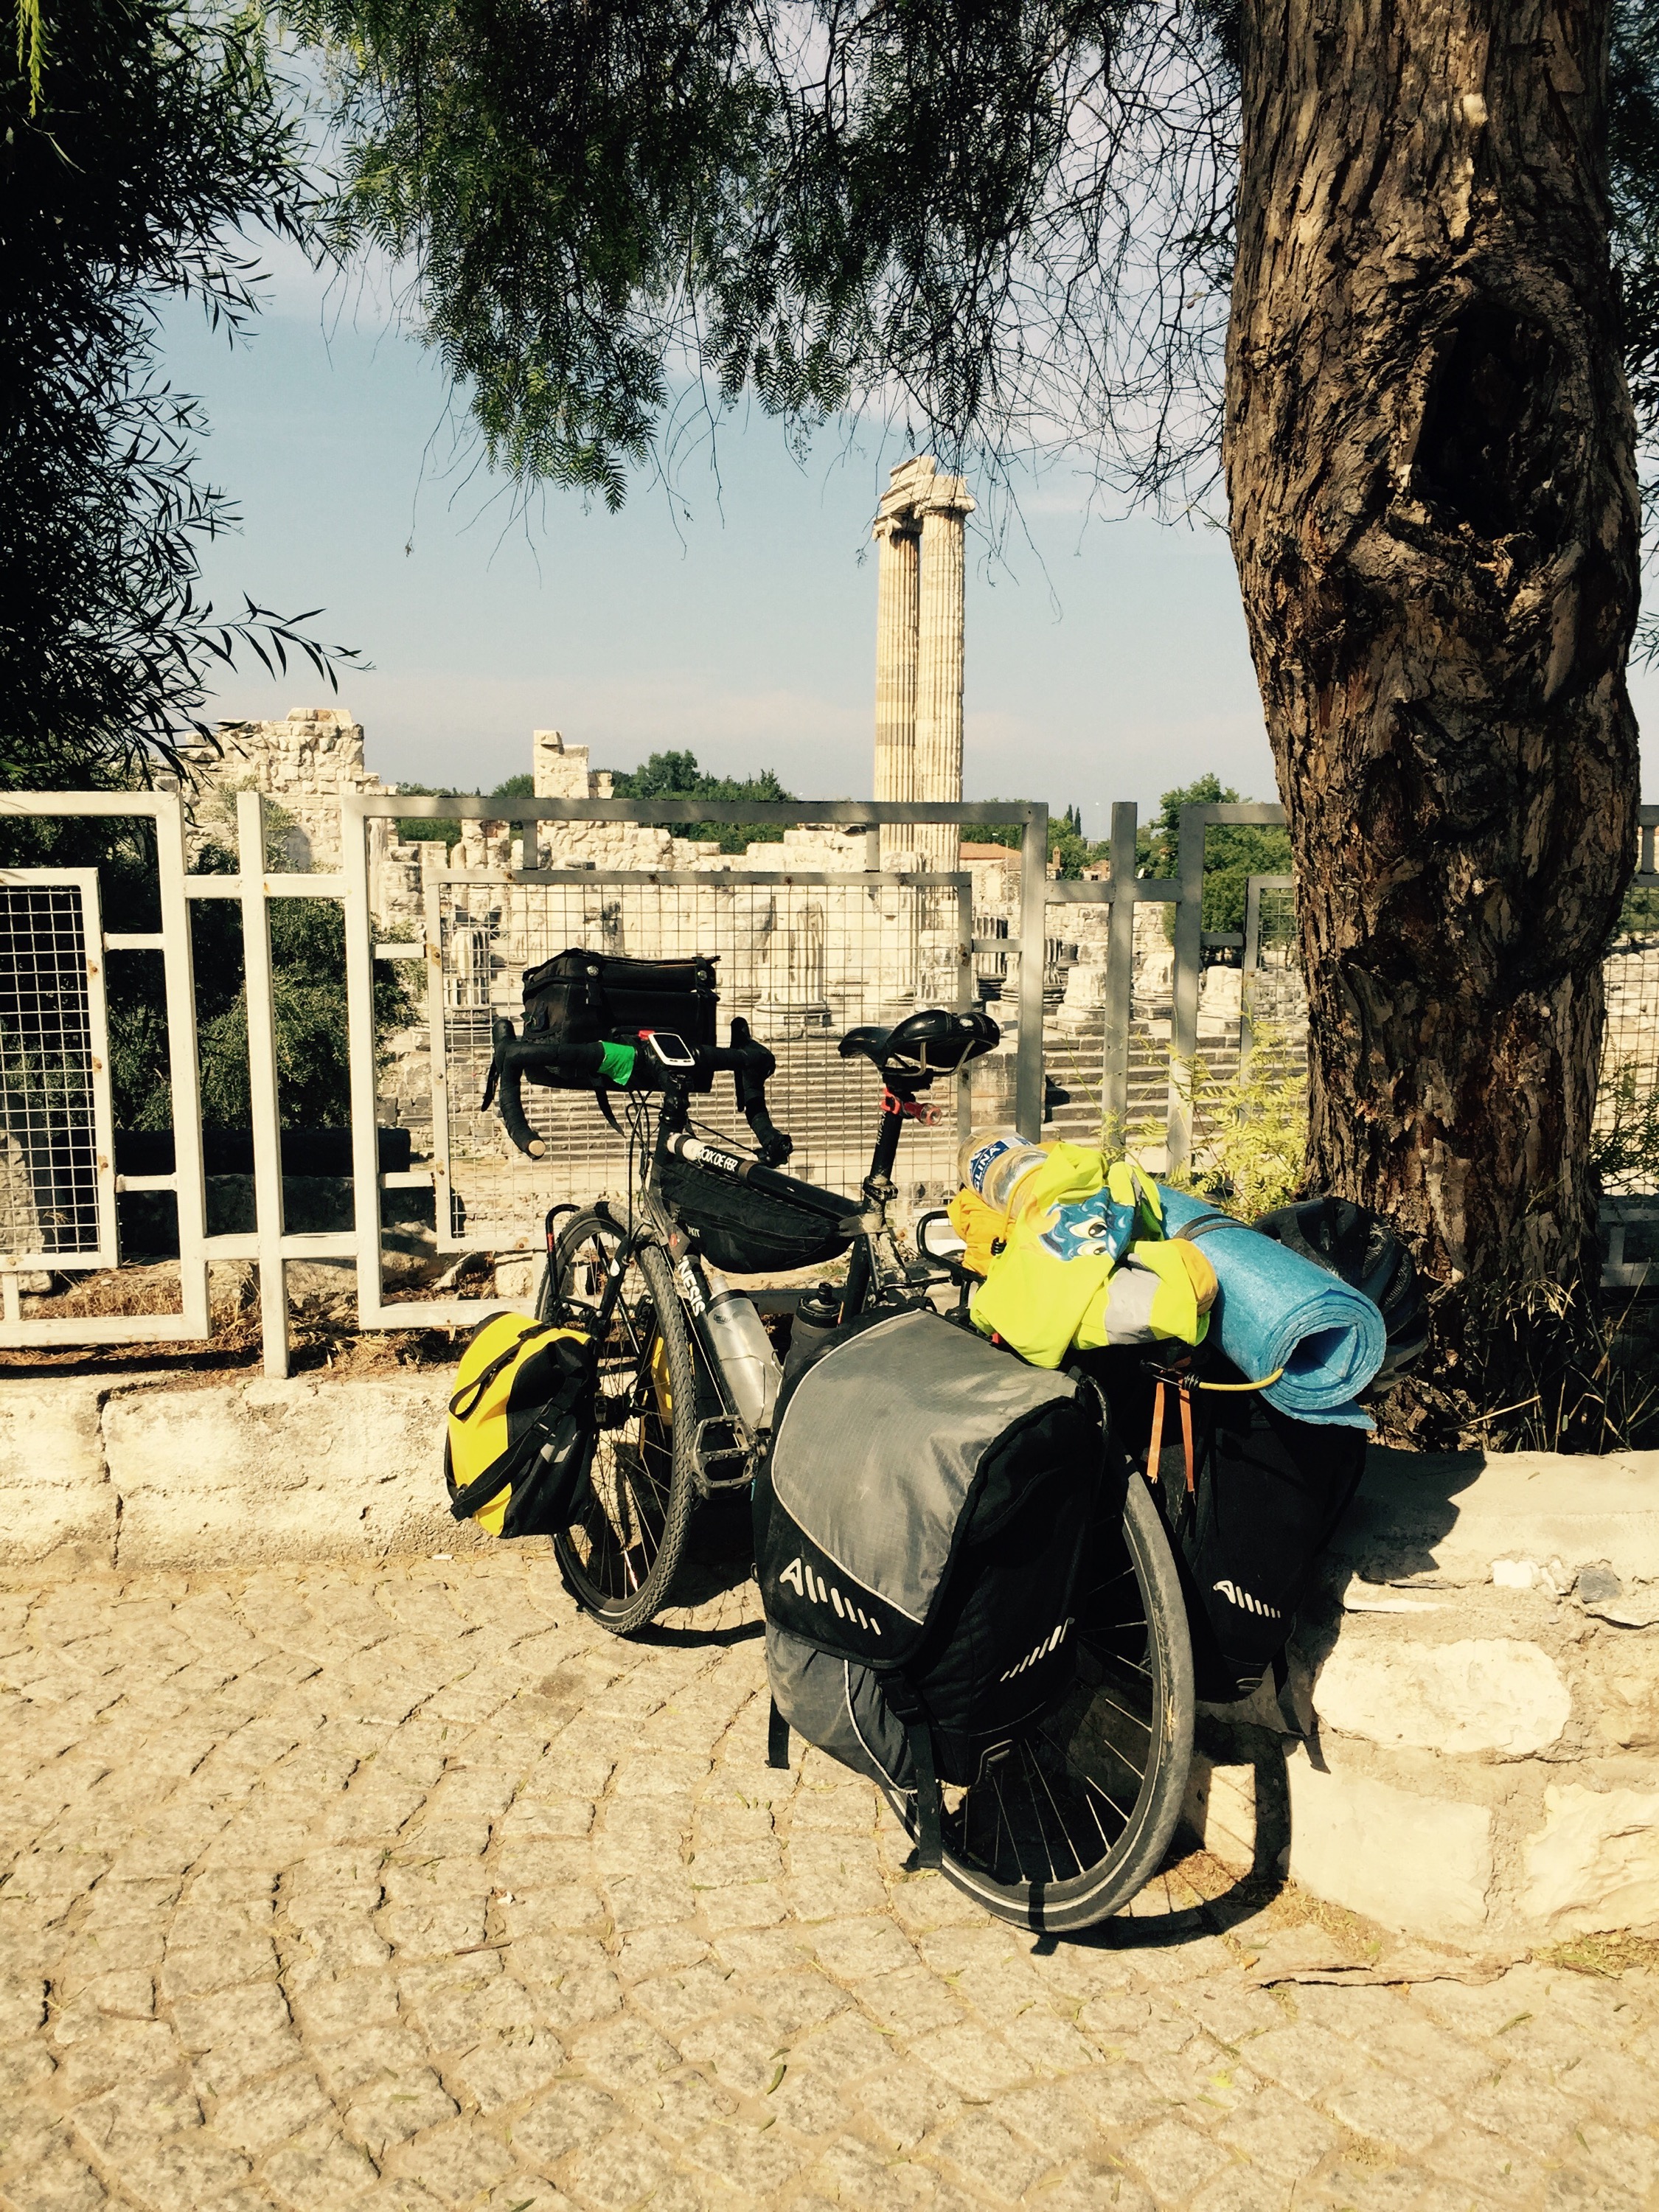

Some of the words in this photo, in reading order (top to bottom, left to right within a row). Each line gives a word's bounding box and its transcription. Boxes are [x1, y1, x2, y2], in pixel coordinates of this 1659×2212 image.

[698, 1147, 716, 1164] ROIX
[714, 1152, 726, 1167] DE
[723, 1157, 738, 1172] FER
[678, 1255, 706, 1317] NESIS
